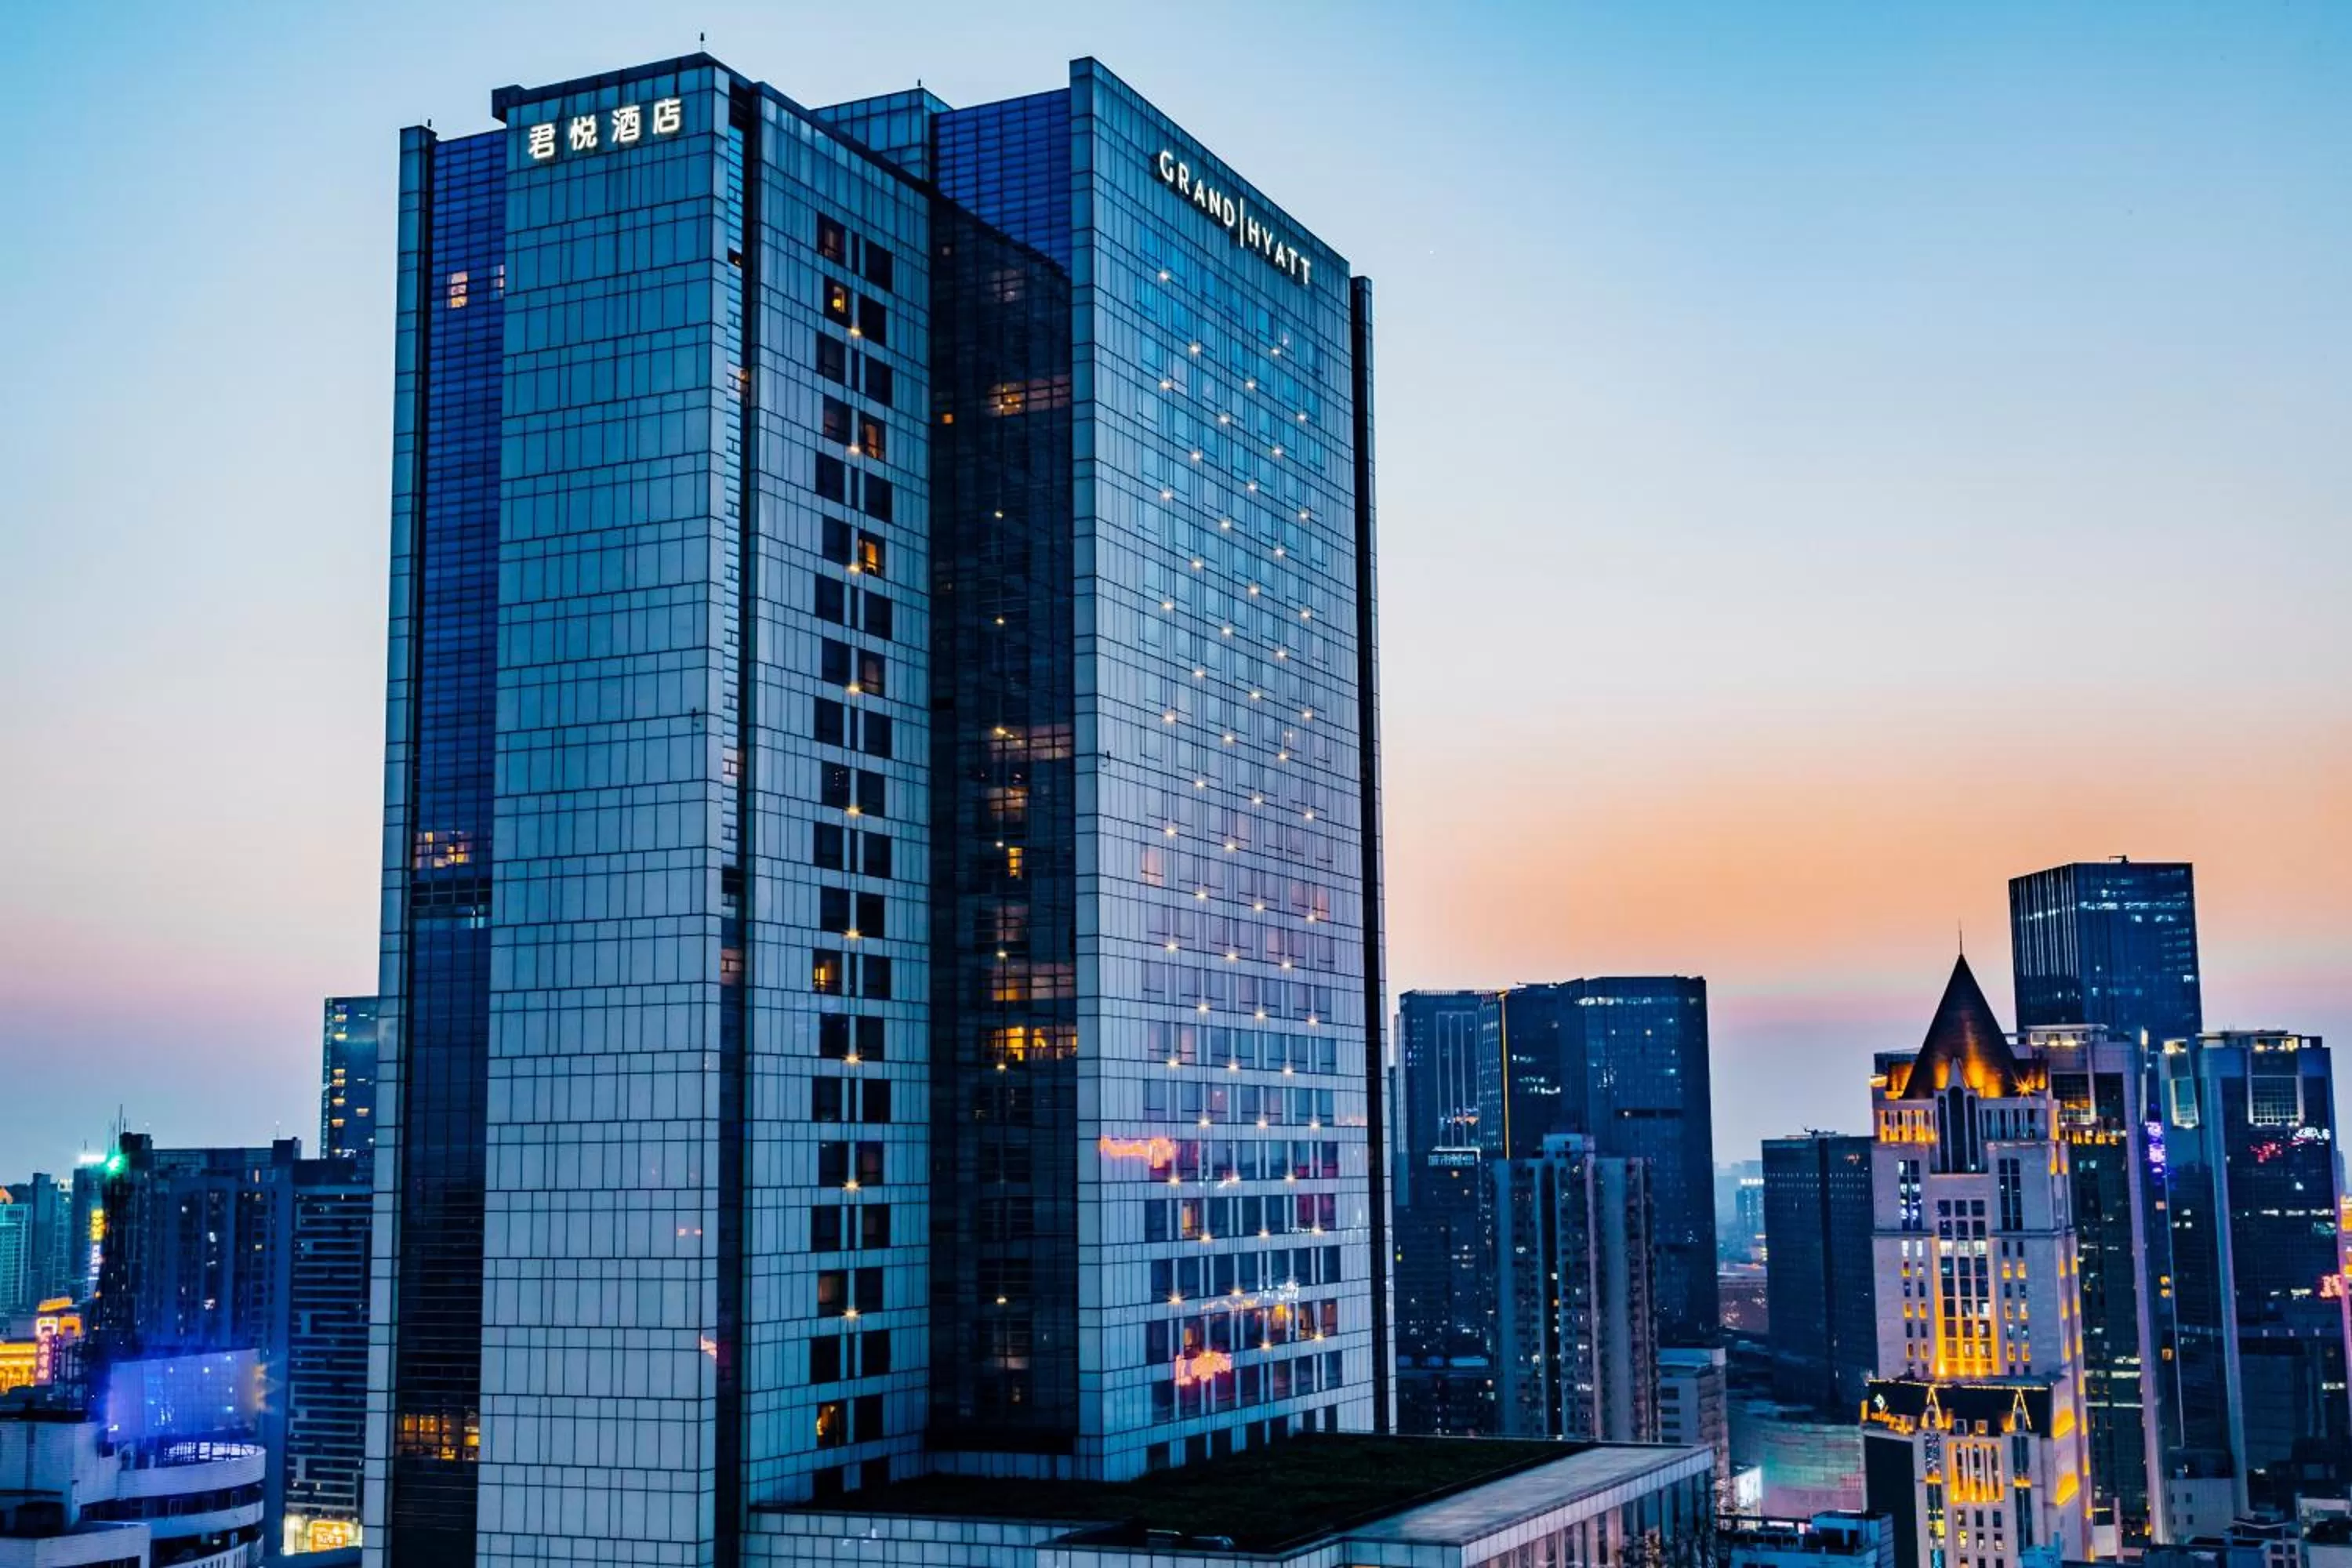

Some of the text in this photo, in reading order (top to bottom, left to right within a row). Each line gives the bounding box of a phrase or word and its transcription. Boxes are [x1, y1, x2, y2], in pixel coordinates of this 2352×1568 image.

[528, 98, 681, 159] 君悦酒店
[1160, 150, 1311, 285] GRAND HYATT
